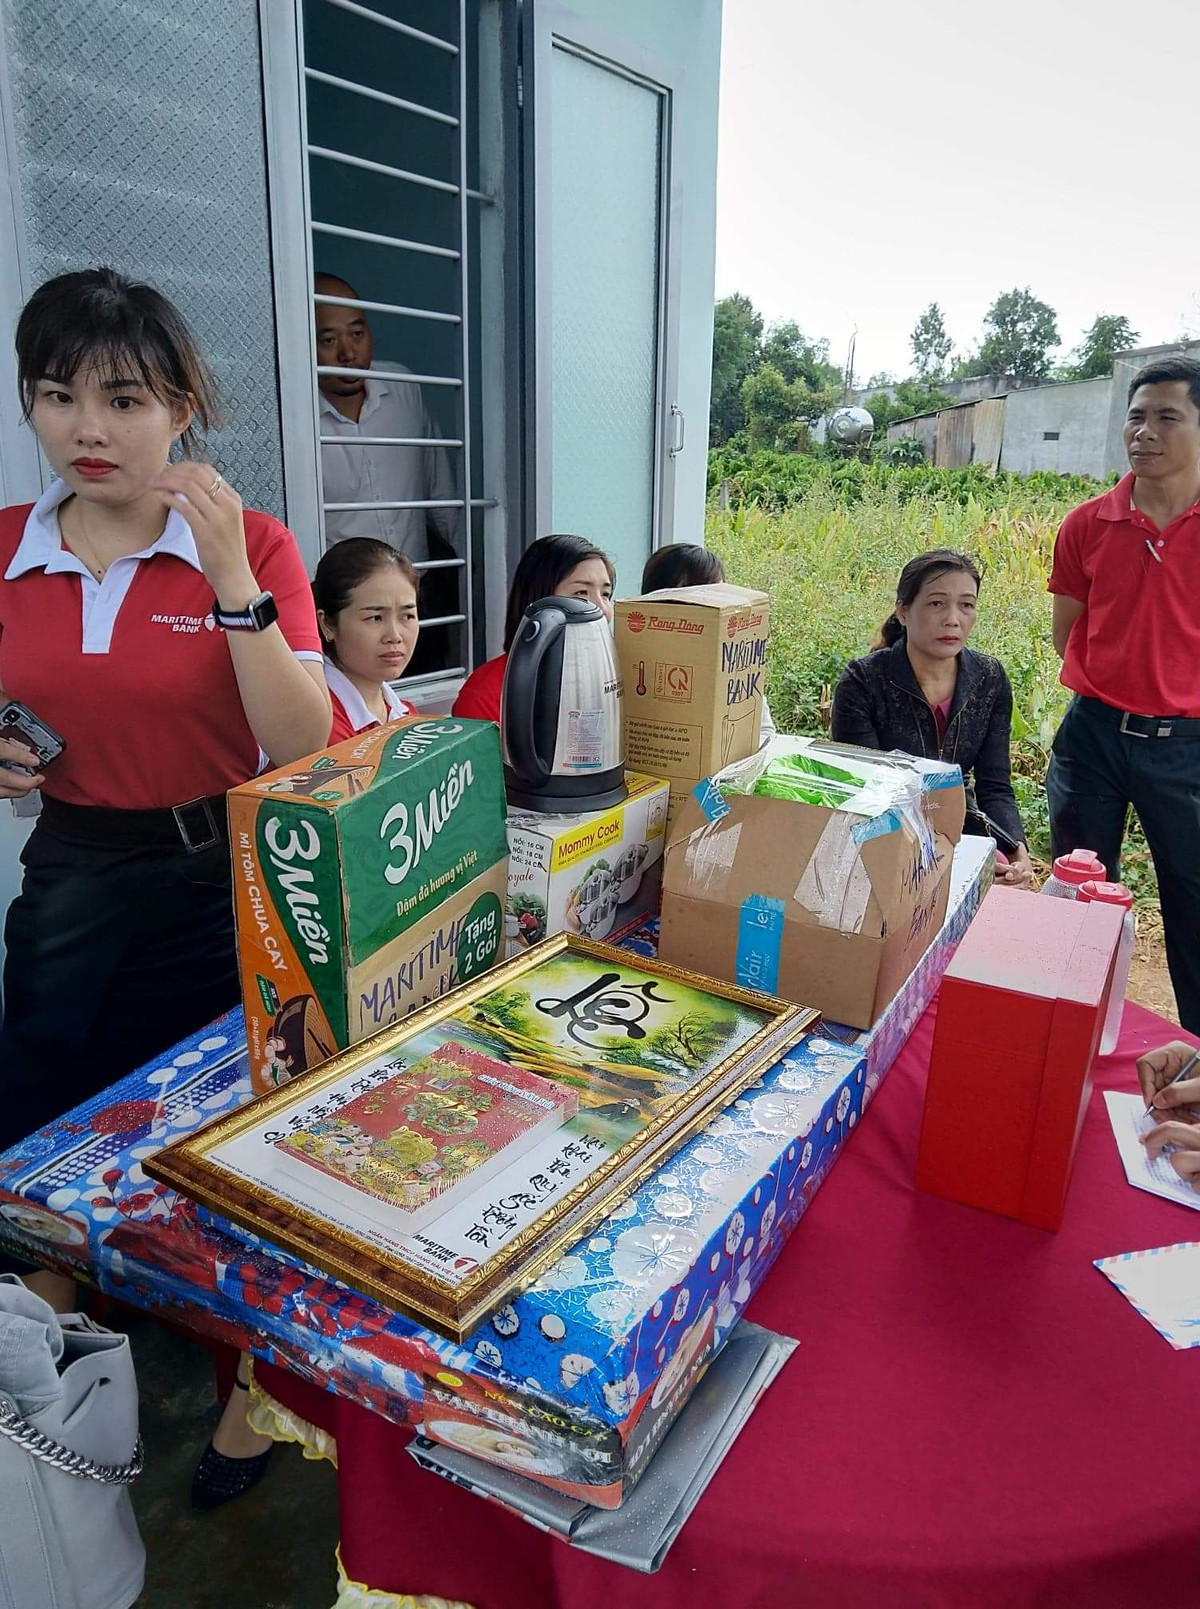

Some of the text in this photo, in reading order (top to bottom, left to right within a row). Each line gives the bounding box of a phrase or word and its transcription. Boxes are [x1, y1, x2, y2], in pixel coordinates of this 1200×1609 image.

[151, 614, 203, 625] MARITIME
[172, 624, 201, 634] BANK
[726, 672, 762, 706] BANK
[535, 843, 545, 851] CM
[558, 819, 620, 859] Mommy Cook
[534, 852, 544, 860] CM
[419, 885, 430, 900] đà
[455, 863, 463, 878] vị
[463, 850, 479, 869] Việt
[508, 868, 535, 887] oyale
[241, 851, 255, 882] TÔM
[248, 885, 270, 934] CHUA
[264, 934, 288, 971] CAY
[464, 910, 497, 944] Tặng
[464, 929, 497, 974] 2 Gói
[413, 1234, 459, 1260] MARITIME
[426, 1247, 450, 1263] BANK
